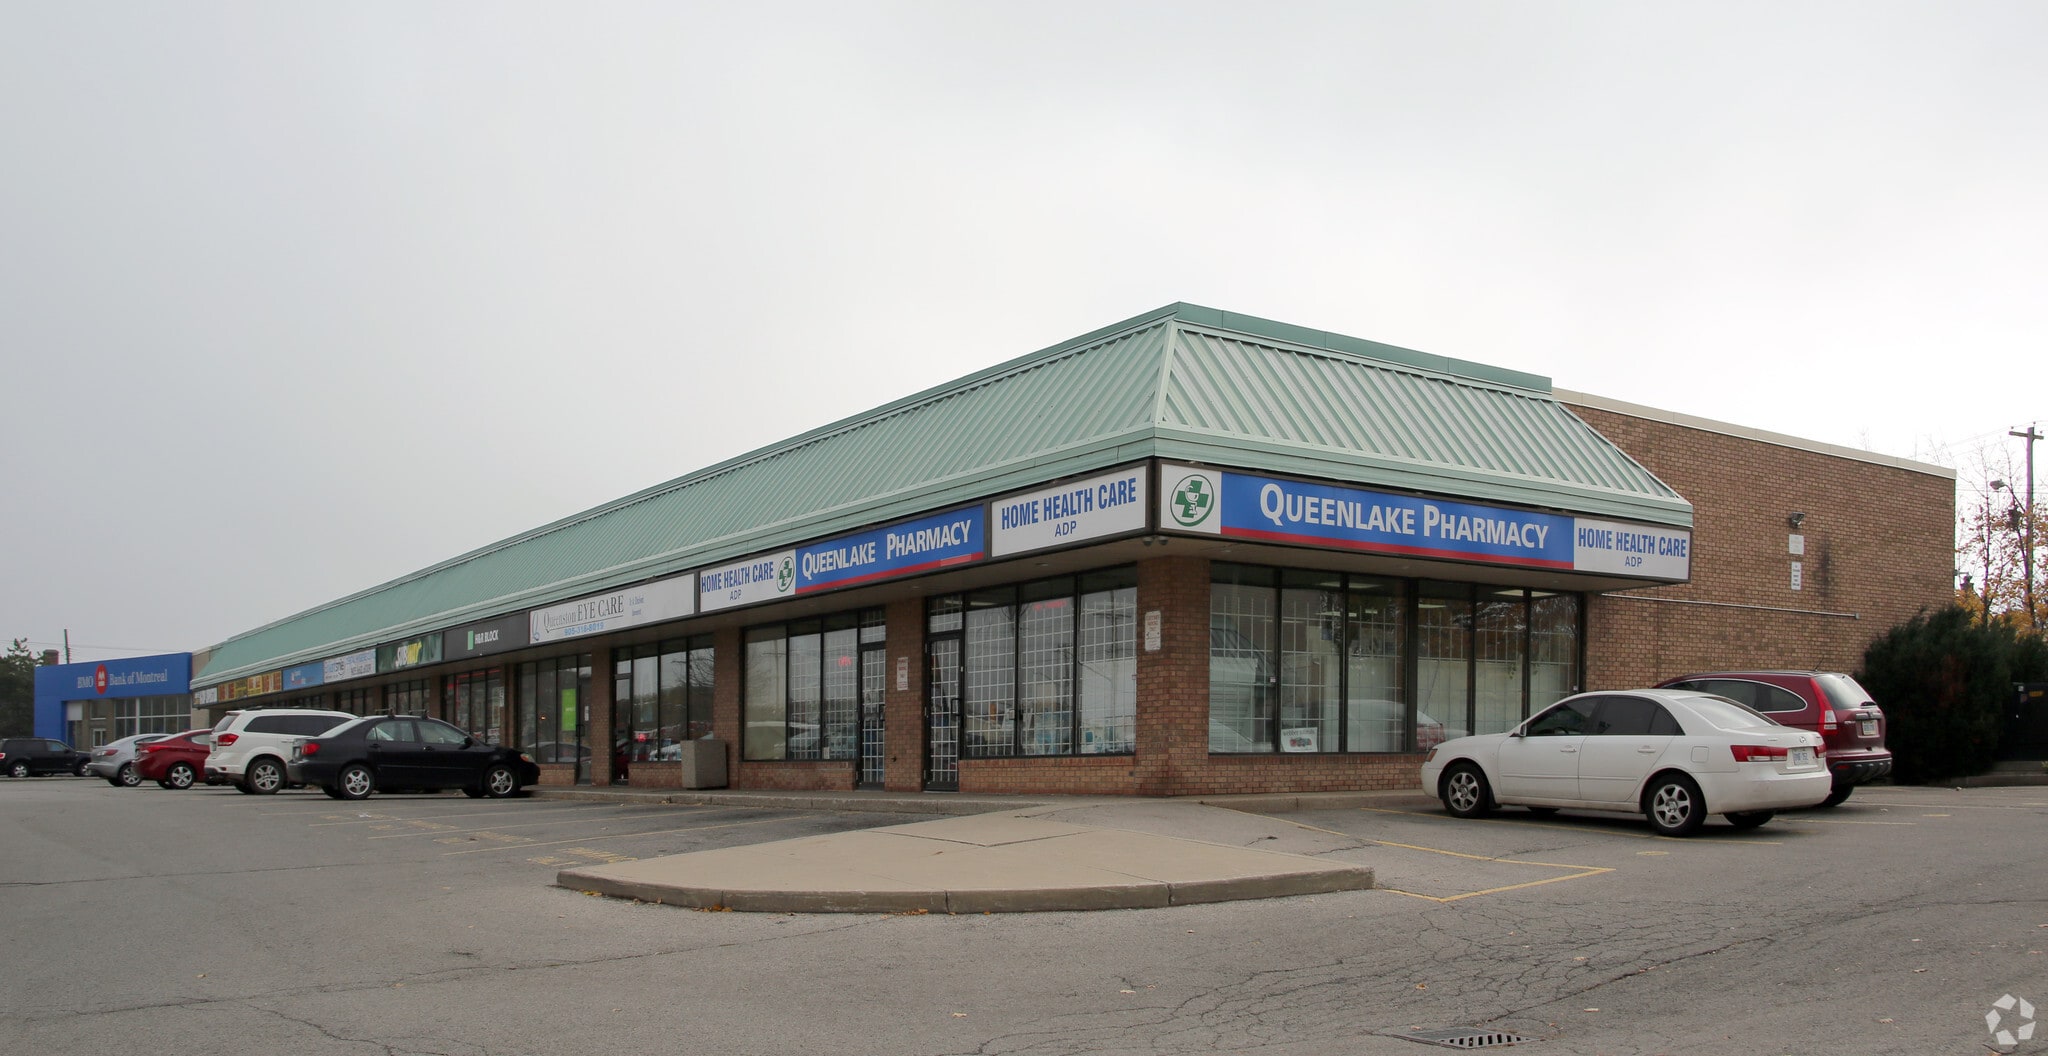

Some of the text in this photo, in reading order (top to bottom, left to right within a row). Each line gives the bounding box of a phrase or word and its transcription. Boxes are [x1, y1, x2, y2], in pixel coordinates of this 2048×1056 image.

[1001, 477, 1137, 530] HOME HEALTH CARE
[1260, 483, 1548, 550] QUEENLAKE PHARMACY
[1055, 521, 1077, 537] ADP
[1578, 528, 1686, 557] HOME HEALTH CARE
[802, 519, 972, 580] QUEENLAKE PHARMACY
[1625, 556, 1643, 568] ADP
[701, 561, 774, 594] HOME HEALTH CARE
[729, 589, 742, 601] ADP
[543, 610, 577, 633] Queenston
[577, 601, 595, 621] EYE
[598, 595, 624, 618] CARE
[484, 629, 499, 642] BLOCK
[77, 668, 168, 689] BMO Bank of Montreal
